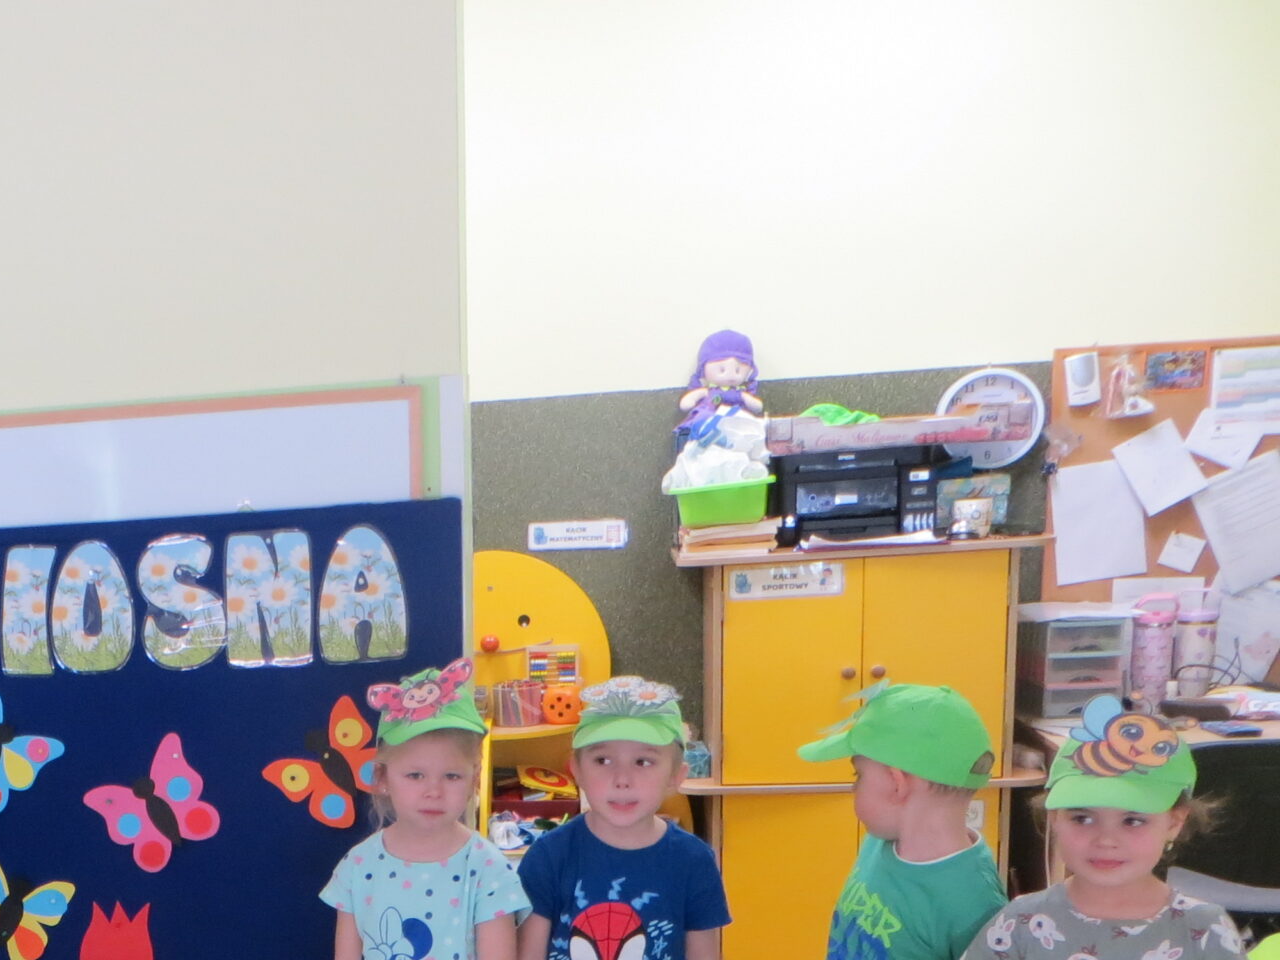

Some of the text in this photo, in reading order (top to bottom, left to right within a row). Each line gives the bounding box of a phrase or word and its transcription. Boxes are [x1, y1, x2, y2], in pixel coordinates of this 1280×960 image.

[984, 377, 997, 387] 12
[965, 384, 975, 393] 11
[984, 450, 991, 460] 6
[761, 583, 808, 591] SPORTOWY
